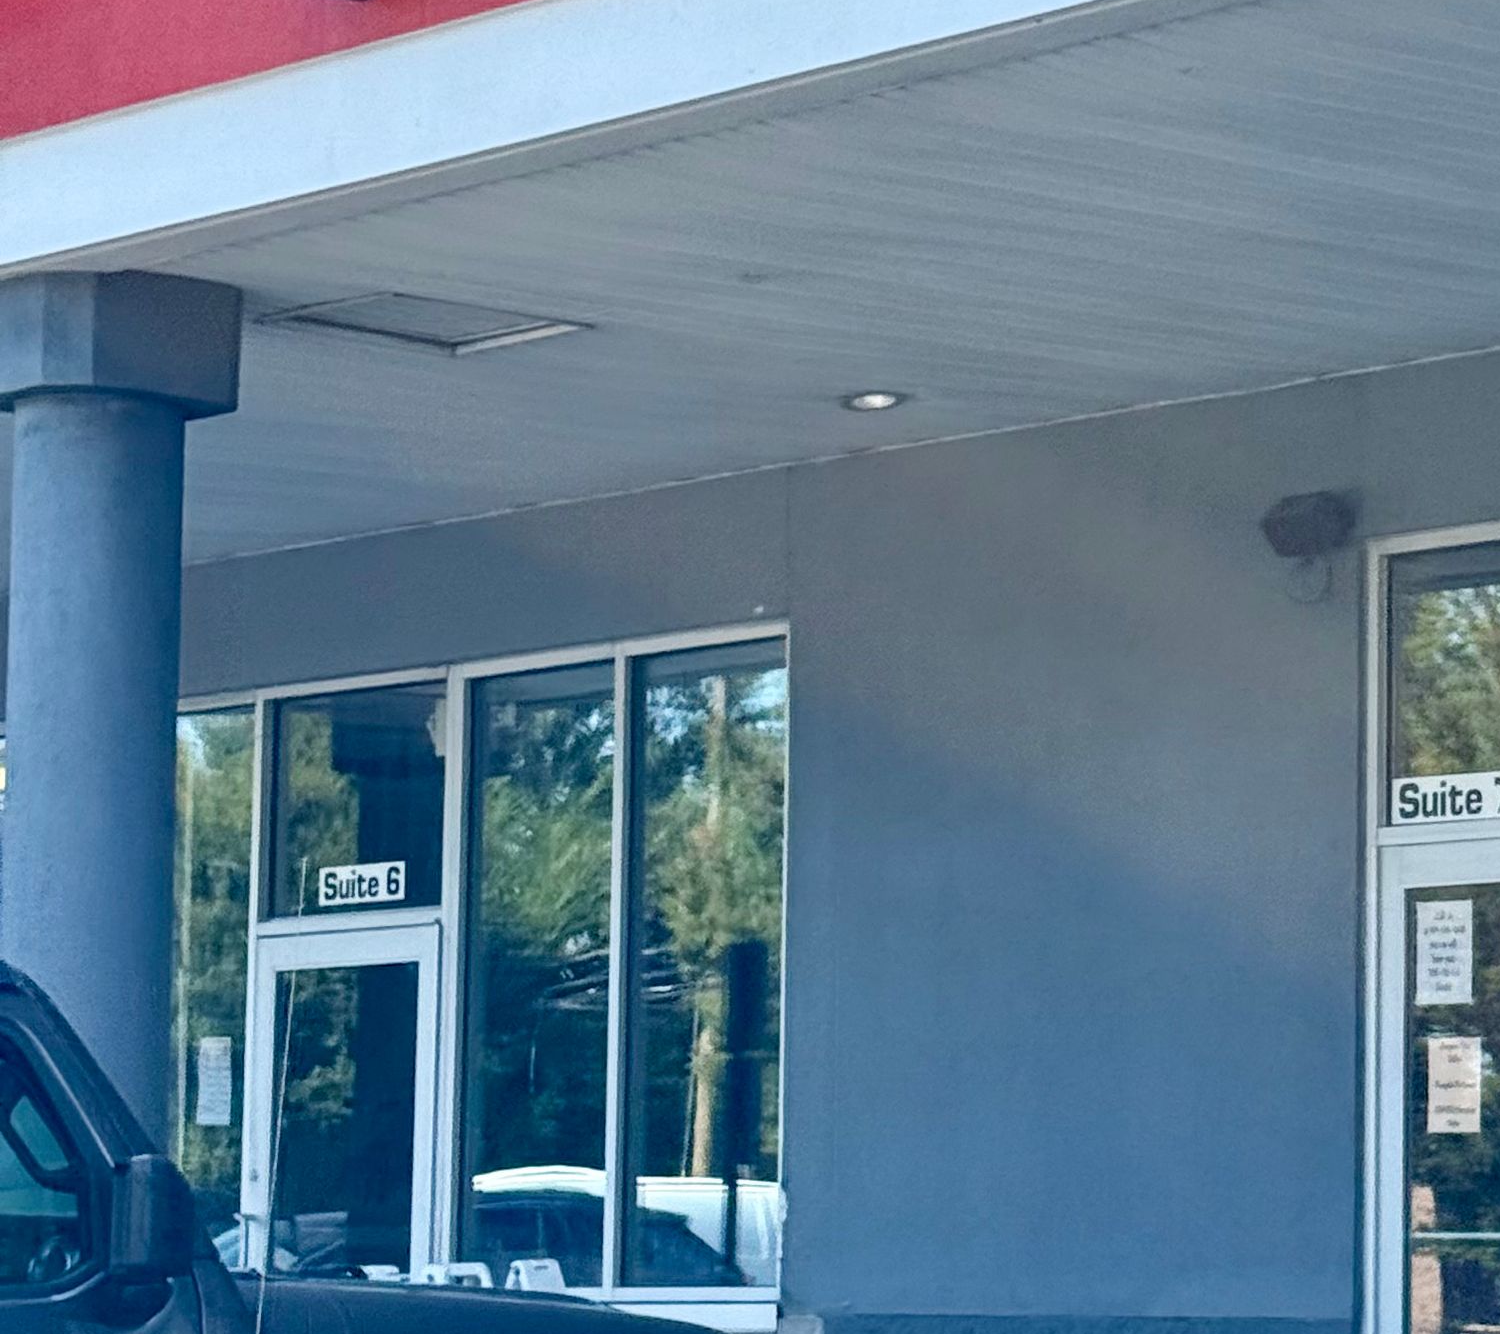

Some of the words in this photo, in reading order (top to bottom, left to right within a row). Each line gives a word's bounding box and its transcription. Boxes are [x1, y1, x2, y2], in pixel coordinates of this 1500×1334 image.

[1399, 780, 1483, 819] Suite
[324, 869, 379, 901] Suite
[386, 866, 401, 896] 6
